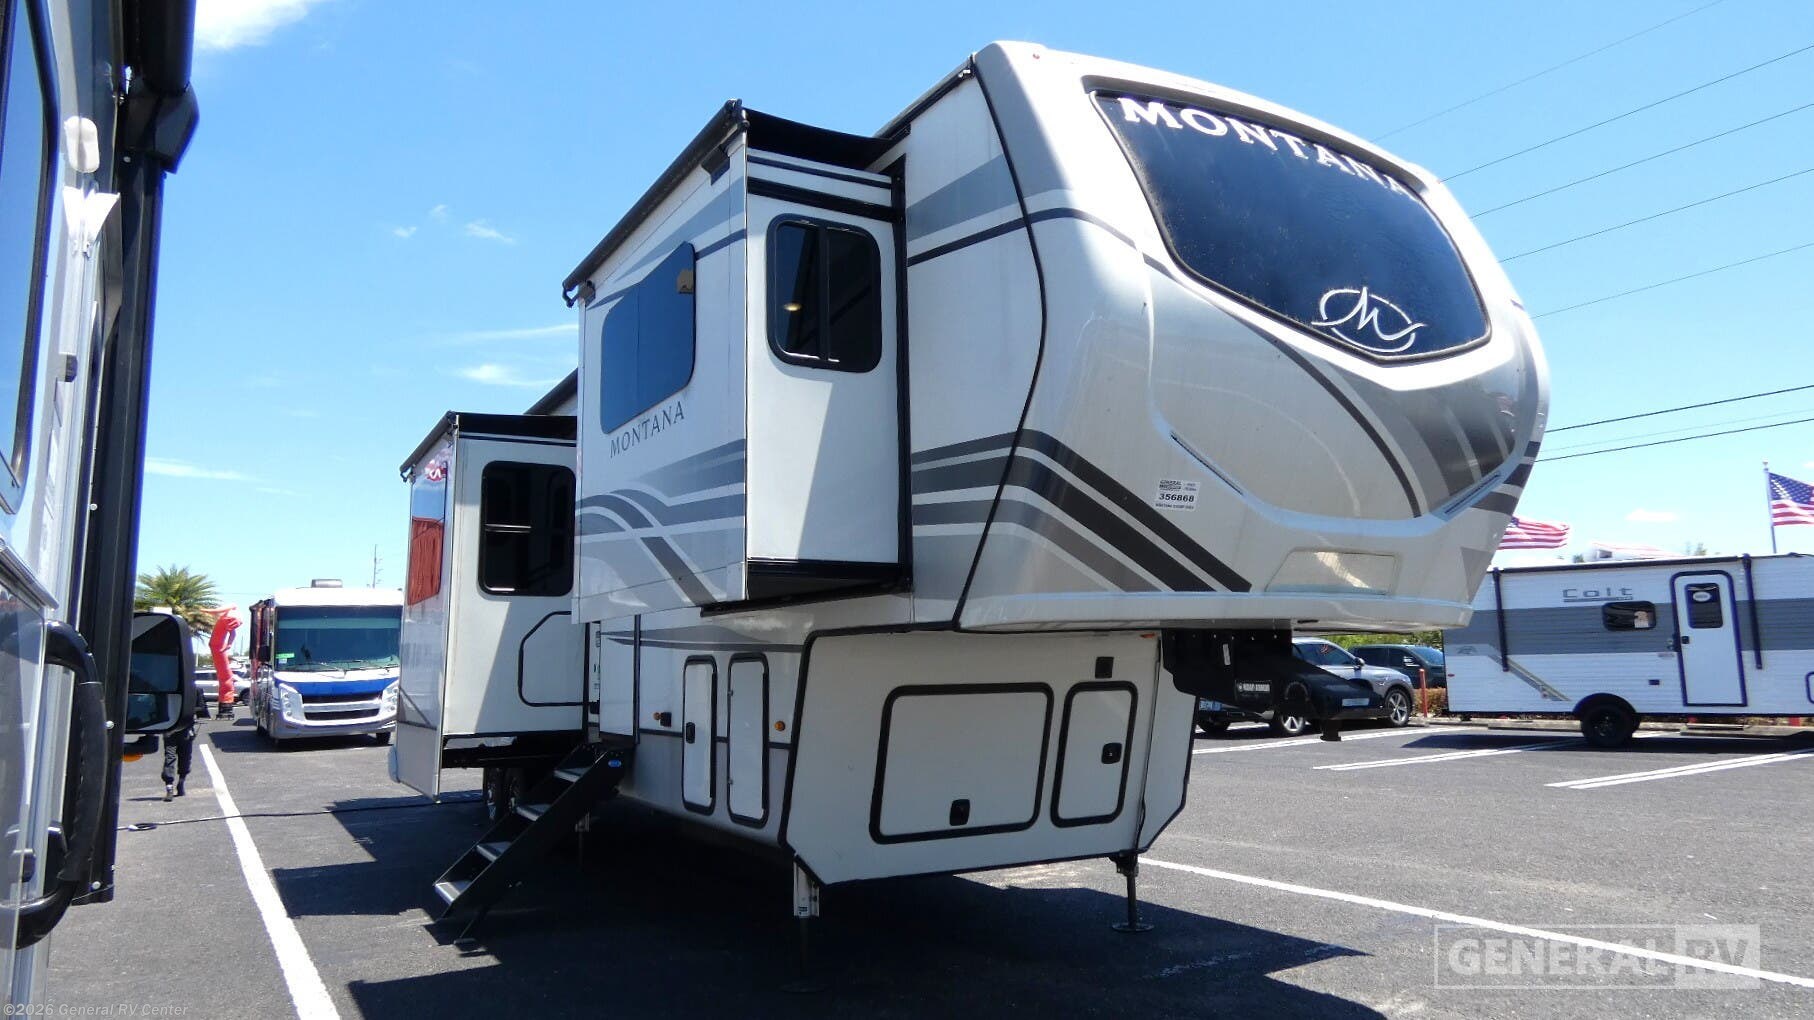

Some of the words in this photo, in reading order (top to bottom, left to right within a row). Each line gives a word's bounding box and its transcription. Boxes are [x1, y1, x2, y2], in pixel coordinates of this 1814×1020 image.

[1118, 97, 1404, 195] MONTANA
[609, 401, 685, 459] MONTANA
[1158, 493, 1195, 502] 356868
[1562, 587, 1633, 598] Colt
